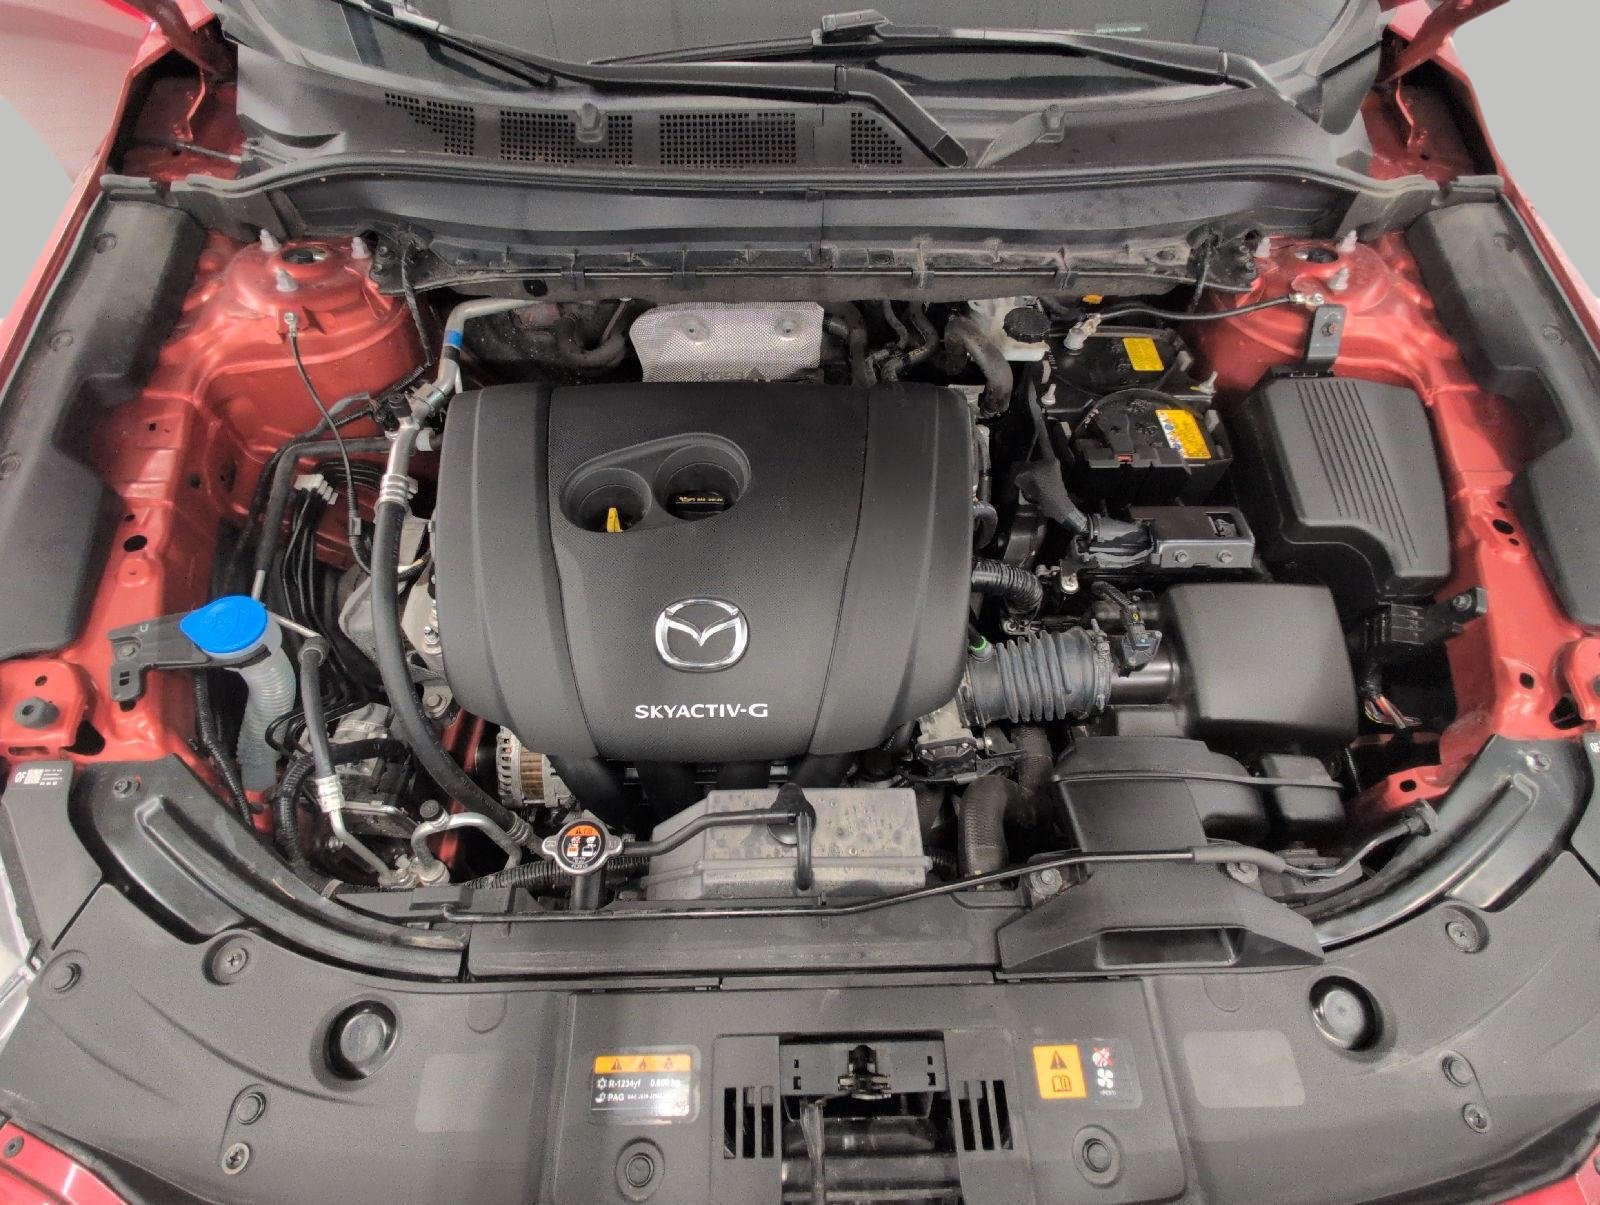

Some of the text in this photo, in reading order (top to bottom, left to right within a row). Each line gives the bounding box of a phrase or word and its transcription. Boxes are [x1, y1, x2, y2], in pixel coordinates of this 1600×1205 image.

[635, 703, 768, 719] SKYACTIV-G
[608, 1078, 641, 1090] R-1234yf
[608, 1092, 625, 1102] PAG
